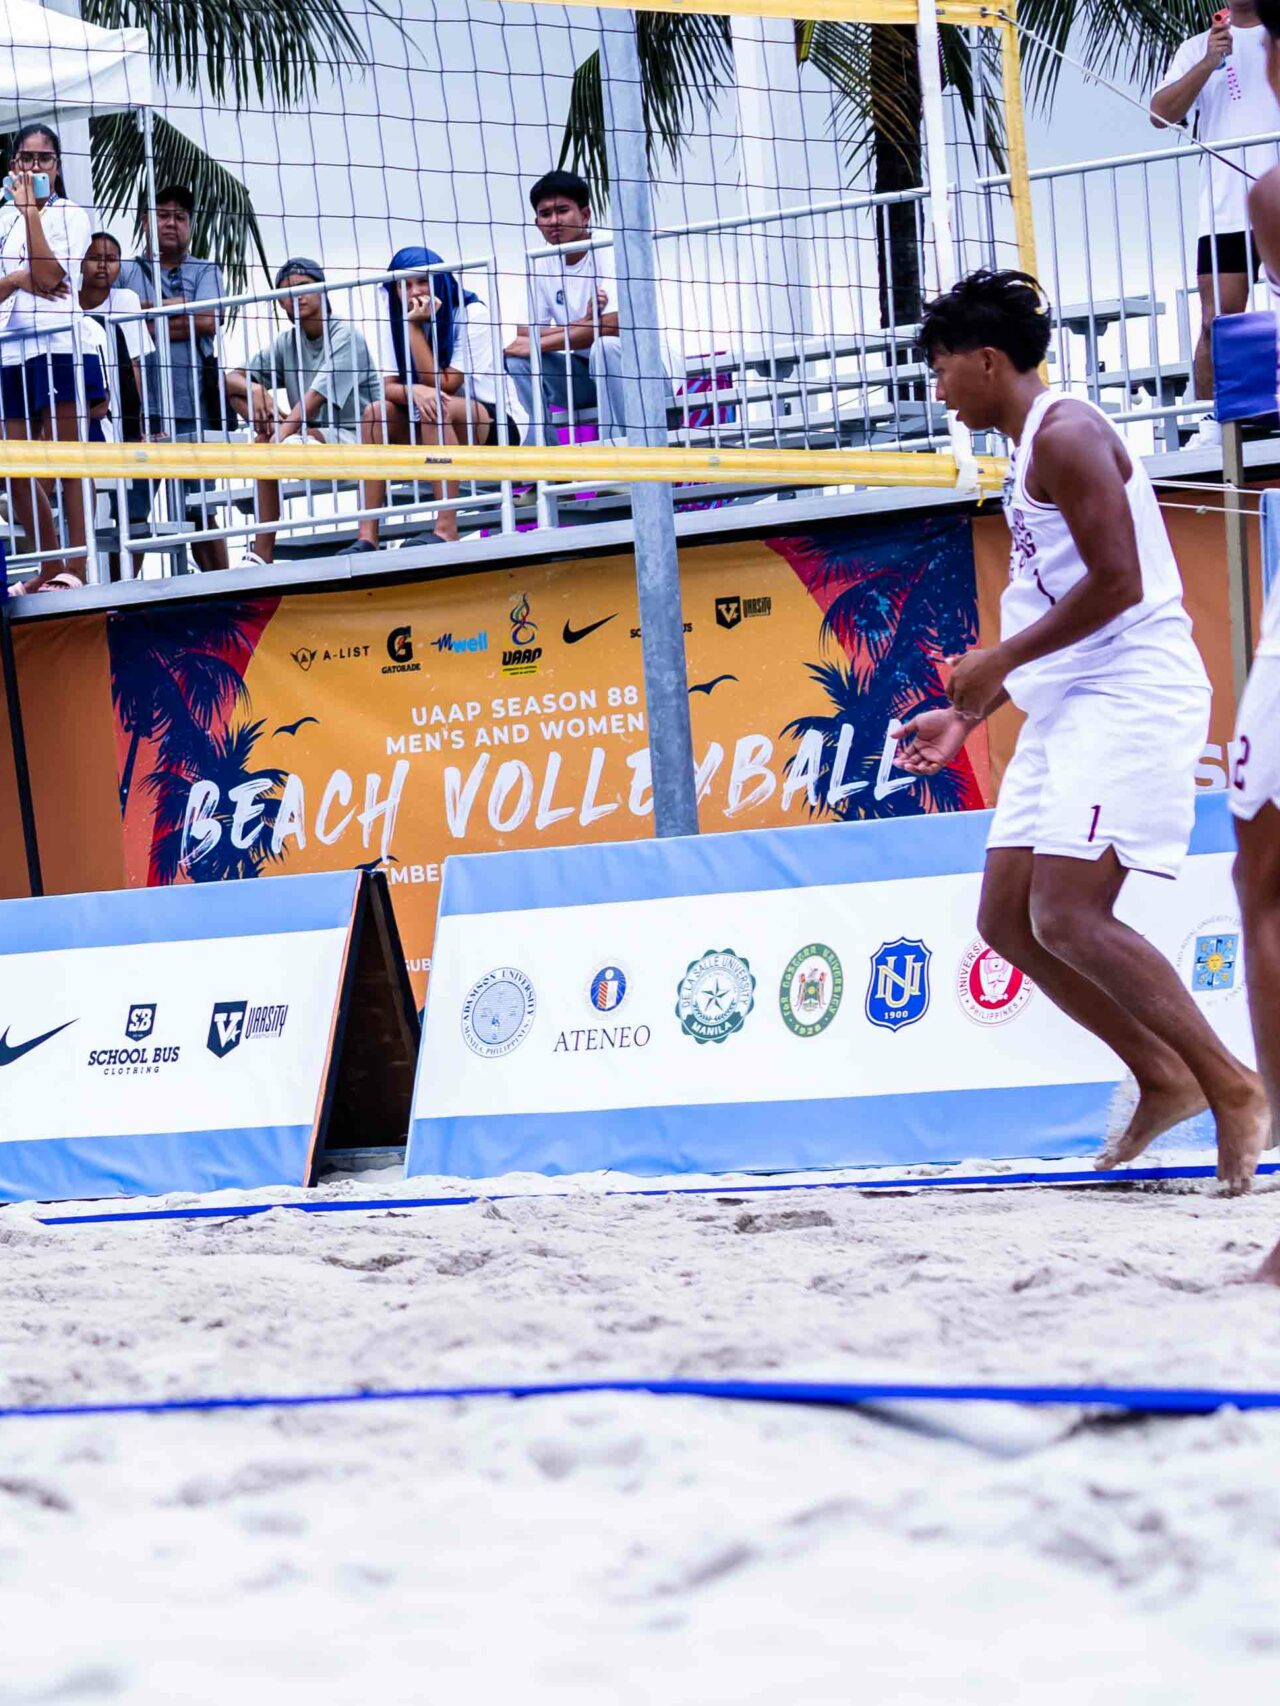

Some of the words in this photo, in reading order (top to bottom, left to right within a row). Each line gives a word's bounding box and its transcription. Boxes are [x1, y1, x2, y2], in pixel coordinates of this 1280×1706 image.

[323, 645, 370, 661] A-LIST
[502, 647, 542, 666] UAAP
[381, 662, 422, 674] GATORADE
[411, 701, 482, 727] UAAP
[491, 689, 598, 720] SEASON
[607, 685, 639, 708] 88
[385, 729, 466, 756] MEN'S
[474, 723, 530, 747] AND
[539, 712, 645, 741] WOMEN
[177, 759, 410, 865] BEACH
[1087, 804, 1101, 842] 1
[694, 955, 720, 979] SALLE
[721, 956, 750, 1007] UNIVERSITY
[959, 942, 985, 998] UNIVERSI
[884, 1010, 909, 1020] 1900
[553, 1024, 651, 1053] ATENEO
[691, 1021, 733, 1036] MANILA
[87, 1048, 149, 1066] SCHOOL
[151, 1046, 181, 1063] BUS
[103, 1066, 160, 1075] CLOTHING
